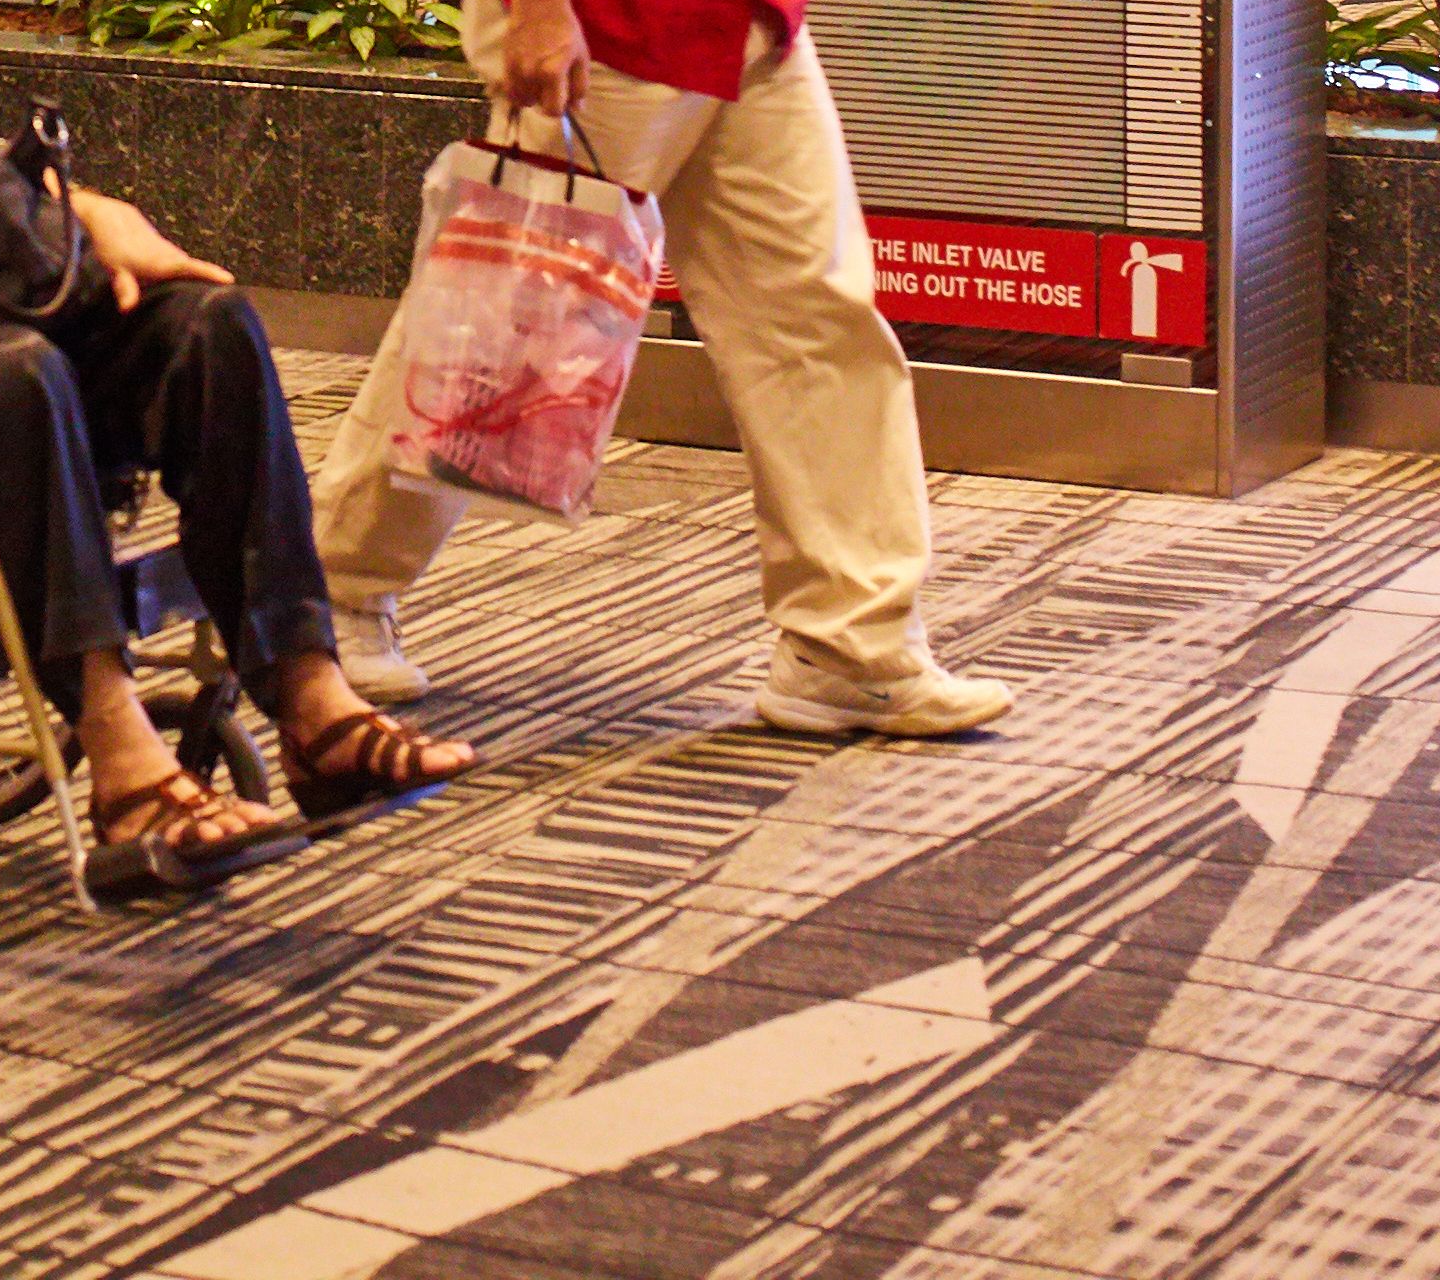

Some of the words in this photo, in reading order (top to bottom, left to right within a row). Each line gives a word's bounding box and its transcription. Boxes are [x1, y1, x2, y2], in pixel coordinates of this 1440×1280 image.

[870, 238, 906, 262] THE
[912, 242, 972, 267] INLET
[978, 246, 1046, 274] VALVE
[924, 274, 968, 298] OUT
[973, 278, 1016, 303] THE
[1022, 282, 1082, 308] HOSE
